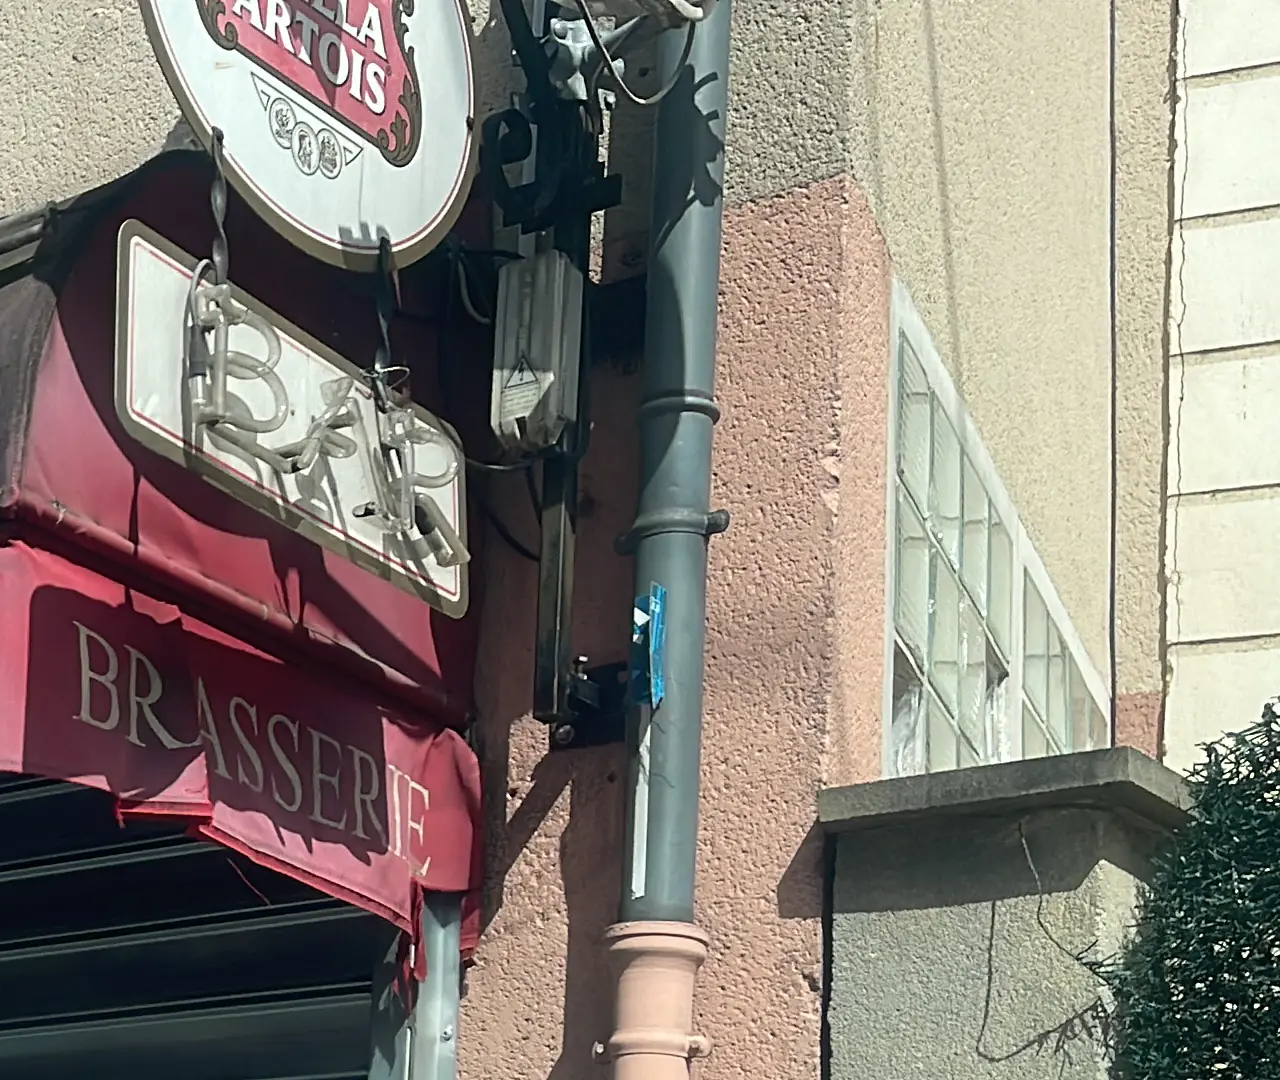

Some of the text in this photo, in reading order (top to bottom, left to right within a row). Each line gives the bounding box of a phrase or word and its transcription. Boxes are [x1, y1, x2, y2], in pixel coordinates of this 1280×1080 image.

[232, 0, 386, 115] ARTOIS
[193, 284, 471, 568] BAR
[73, 620, 431, 877] BRASSERIE
